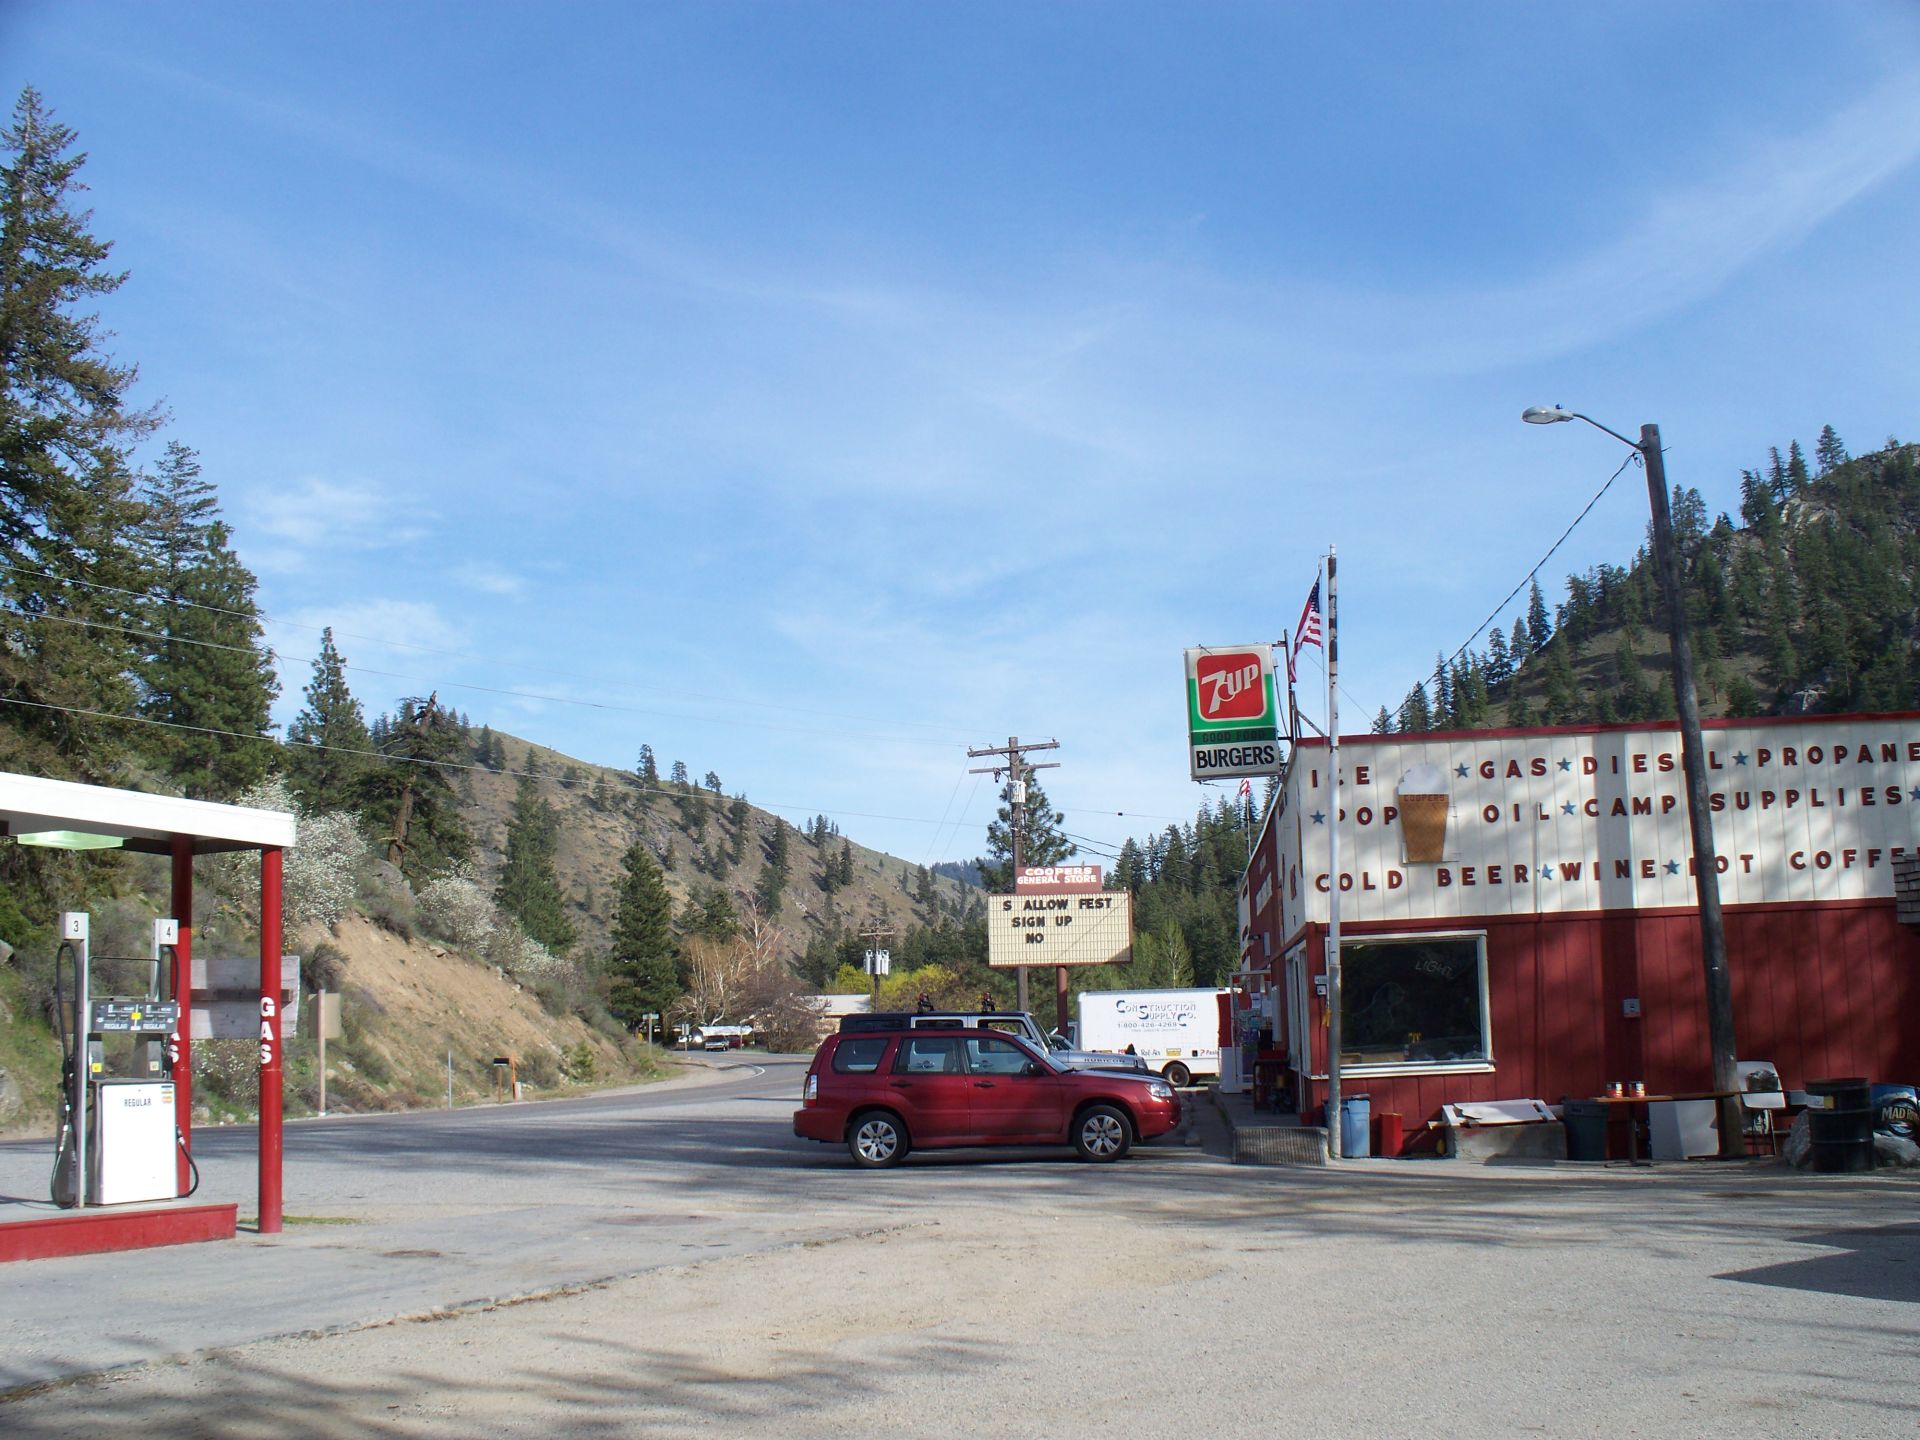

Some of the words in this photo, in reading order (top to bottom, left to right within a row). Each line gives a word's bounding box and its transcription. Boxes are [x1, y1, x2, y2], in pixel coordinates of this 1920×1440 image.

[1196, 745, 1275, 769] BURGERS
[1480, 757, 1547, 779] GAS
[1583, 751, 1723, 775] DIESL
[1758, 743, 1920, 767] PROPANE
[1483, 803, 1549, 823] OIL
[1584, 795, 1676, 817] CAMP
[1710, 786, 1902, 811] SUPPLIES
[1025, 867, 1093, 876] COOPERS
[1315, 870, 1404, 893] COLD
[1437, 864, 1529, 888] BEER
[1559, 859, 1656, 881] WINE
[1017, 875, 1060, 884] GENERAL
[1064, 874, 1097, 883] STORE
[1023, 899, 1068, 911] ALLOW
[1079, 898, 1112, 909] FEST
[73, 920, 79, 933] 3
[1012, 916, 1045, 928] SIGN
[1056, 915, 1072, 927] UP
[166, 926, 171, 937] 4
[1025, 933, 1044, 944] NO
[260, 996, 275, 1065] GAS
[124, 1098, 152, 1107] REGULAR
[1881, 1105, 1906, 1121] MAD
